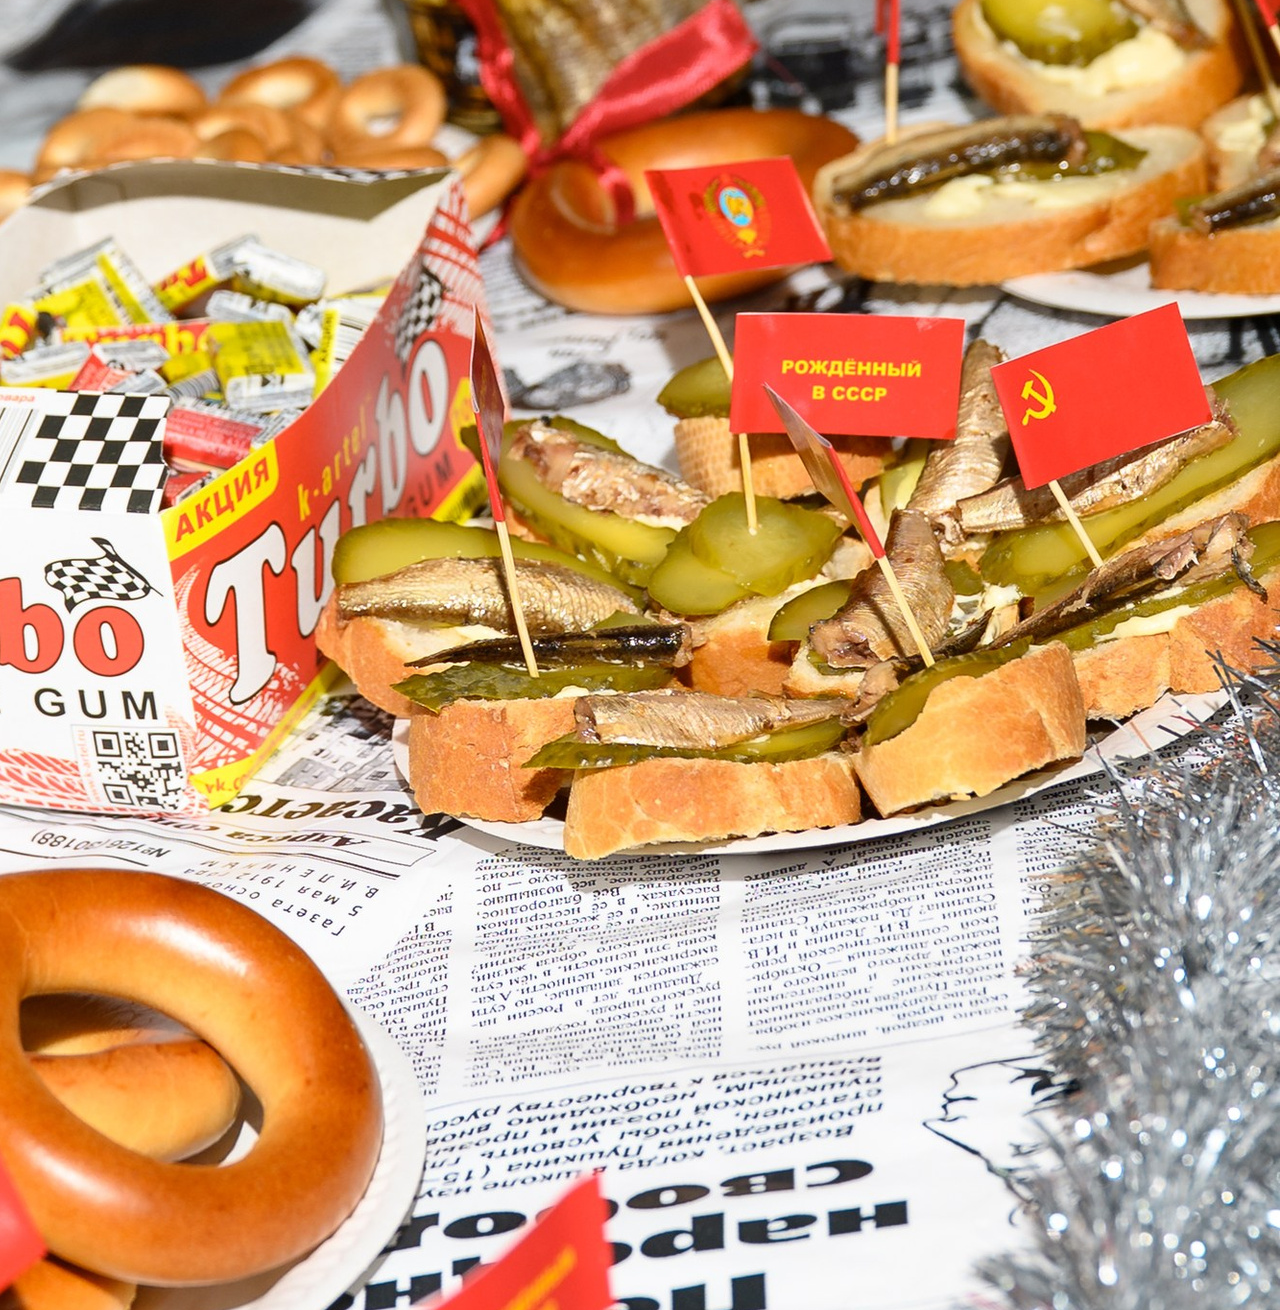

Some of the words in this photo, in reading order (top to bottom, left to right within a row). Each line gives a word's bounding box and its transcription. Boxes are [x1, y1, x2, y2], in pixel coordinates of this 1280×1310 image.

[781, 357, 923, 379] РОЖДЁННЫЙ
[812, 386, 826, 400] В
[830, 386, 887, 402] СССР
[173, 459, 270, 546] АКЦИЯ
[204, 338, 450, 704] Turbo
[32, 681, 162, 724] GUM
[210, 789, 463, 843] Касаетс
[238, 873, 285, 888] 1912
[340, 878, 357, 891] И.
[571, 879, 596, 892] всё
[888, 873, 993, 895] либеральная
[297, 886, 340, 905] мая
[365, 885, 379, 899] В.
[477, 884, 563, 906] возвышаю-
[592, 886, 620, 898] Всё
[636, 884, 720, 901] рассудках,
[934, 882, 993, 898] тивном
[349, 905, 363, 916] 5
[477, 893, 582, 919] благородное,
[592, 901, 608, 913] её
[617, 897, 625, 906] в
[646, 896, 720, 911] цинизме,
[818, 894, 925, 918] изображении
[919, 893, 996, 915] Сталина?
[271, 899, 346, 935] Газета
[476, 907, 581, 931] нестерпимом
[607, 910, 623, 920] её
[630, 907, 638, 915] в
[886, 906, 913, 918] Да,
[942, 904, 996, 920] люции
[526, 914, 600, 931] жестоких
[741, 915, 808, 934] Сталина
[805, 913, 879, 934] пожалуй,
[879, 920, 909, 933] В.И.
[960, 915, 999, 929] ской
[483, 928, 518, 938] пред-
[596, 925, 717, 953] американского
[677, 934, 716, 947] ковы
[743, 931, 783, 944] нега-
[789, 929, 798, 937] в
[805, 927, 866, 946] Ленина
[933, 925, 1000, 945] родного
[644, 944, 670, 954] эти
[748, 945, 778, 959] И.В.
[788, 941, 797, 949] и
[798, 925, 949, 961] социалистической
[847, 942, 927, 962] движения
[941, 938, 1001, 957] вождей
[536, 951, 587, 967] образа
[558, 950, 637, 972] ценности,
[600, 945, 718, 976] американские,
[751, 954, 787, 969] рево-
[867, 952, 931, 969] другого
[900, 949, 1002, 973] историками
[394, 963, 448, 983] многие
[471, 964, 526, 982] жизни,
[509, 974, 537, 986] чём
[543, 969, 551, 977] в
[752, 963, 821, 981] Октябрь-
[783, 967, 857, 988] великого
[868, 973, 877, 981] и
[893, 962, 1004, 986] изображение
[954, 973, 1004, 986] жение
[346, 981, 385, 995] тогда
[470, 981, 503, 993] суть
[516, 972, 595, 995] ценности.
[545, 978, 621, 1000] западные,
[628, 972, 702, 995] Двадцать
[651, 981, 720, 1003] русского
[754, 985, 772, 994] на-
[874, 981, 947, 1002] Пугачёва
[943, 986, 987, 999] Разве
[473, 994, 495, 1004] ка-
[514, 997, 534, 1007] по
[594, 992, 619, 1003] лет
[693, 995, 721, 1006] ние
[747, 981, 845, 1006] писателями
[748, 988, 869, 1016] либеральными
[852, 998, 869, 1006] не
[969, 993, 1009, 1007] ской
[383, 996, 447, 1017] Пушкин
[471, 999, 506, 1017] сути
[507, 1003, 563, 1021] России
[575, 999, 583, 1007] в
[591, 999, 645, 1015] народа.
[816, 994, 937, 1024] допушкинское
[897, 1002, 963, 1020] натурой.
[479, 1018, 496, 1027] на-
[595, 1004, 666, 1024] русского
[749, 1003, 846, 1027] напоминает
[489, 1020, 587, 1041] государства,
[790, 1030, 866, 1048] широкой
[717, 1058, 881, 1093] взрослым,
[508, 1082, 676, 1113] творчеству
[694, 1076, 881, 1115] пушкинской
[735, 1088, 882, 1121] статочен,
[507, 1091, 696, 1126] необходимо
[571, 1109, 681, 1131] поэзии
[659, 1102, 883, 1149] произведения
[541, 1126, 558, 1135] и
[619, 1120, 711, 1140] чтобы
[719, 1124, 854, 1153] Возраст,
[481, 1133, 599, 1159] усвоить
[507, 1145, 643, 1172] Пушкина
[618, 1150, 704, 1170] когда
[481, 1170, 587, 1190] школе
